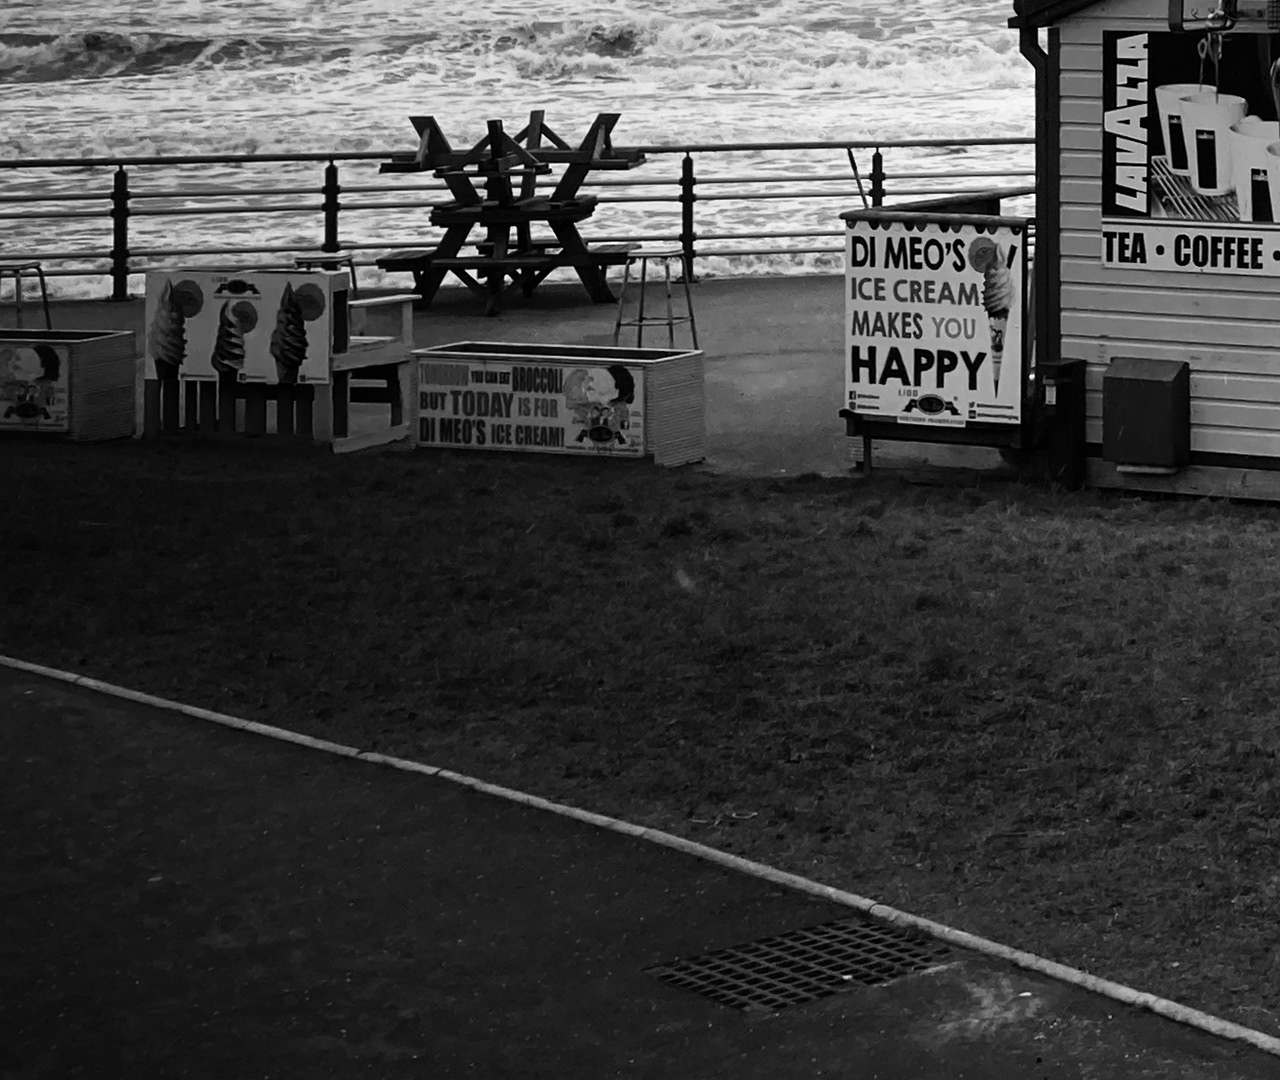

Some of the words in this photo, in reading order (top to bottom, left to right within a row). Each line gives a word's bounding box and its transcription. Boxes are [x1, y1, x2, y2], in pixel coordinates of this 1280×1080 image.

[1104, 33, 1148, 213] LAVAZZA
[851, 235, 876, 268] DI
[884, 236, 966, 272] MEO'S
[1103, 231, 1147, 264] TEA
[1174, 234, 1264, 269] COFFEE
[852, 277, 886, 301] ICE
[893, 279, 980, 307] CREAM
[851, 310, 923, 340] MAKES
[931, 316, 977, 340] YOU
[512, 366, 563, 394] BROCCOLI
[851, 345, 987, 391] HAPPY
[420, 391, 447, 411] BUT
[450, 390, 514, 418] TODAY
[518, 397, 531, 416] IS
[534, 398, 558, 418] FOR
[420, 417, 436, 443] DI
[440, 418, 486, 445] MEO'S
[491, 424, 512, 445] ICE
[515, 425, 565, 448] CREAM!
